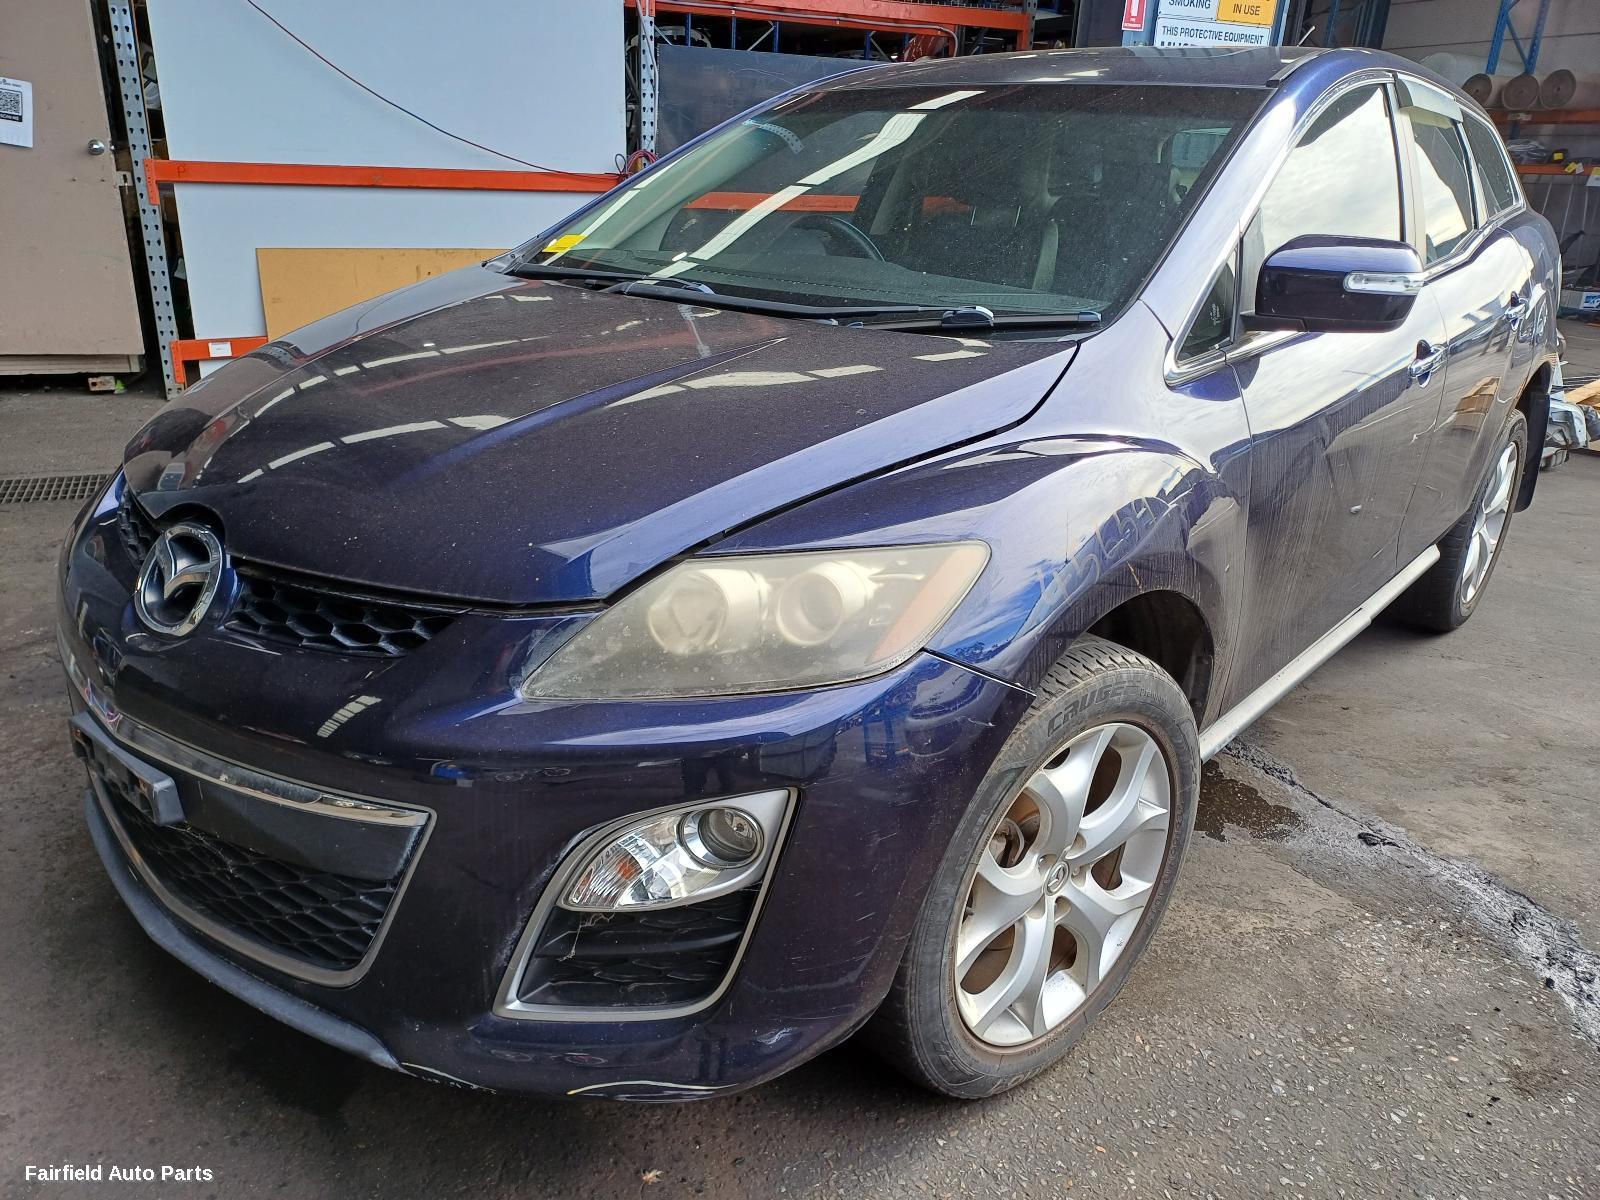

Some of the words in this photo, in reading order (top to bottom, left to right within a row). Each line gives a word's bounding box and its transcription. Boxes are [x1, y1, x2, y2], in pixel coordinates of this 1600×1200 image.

[1168, 0, 1211, 9] SMOKING
[1233, 3, 1243, 14] IN
[1244, 5, 1261, 16] USE
[1162, 25, 1179, 37] THIS
[1180, 27, 1223, 41] PROTECTIVE
[1224, 31, 1264, 45] EQUIPMENT
